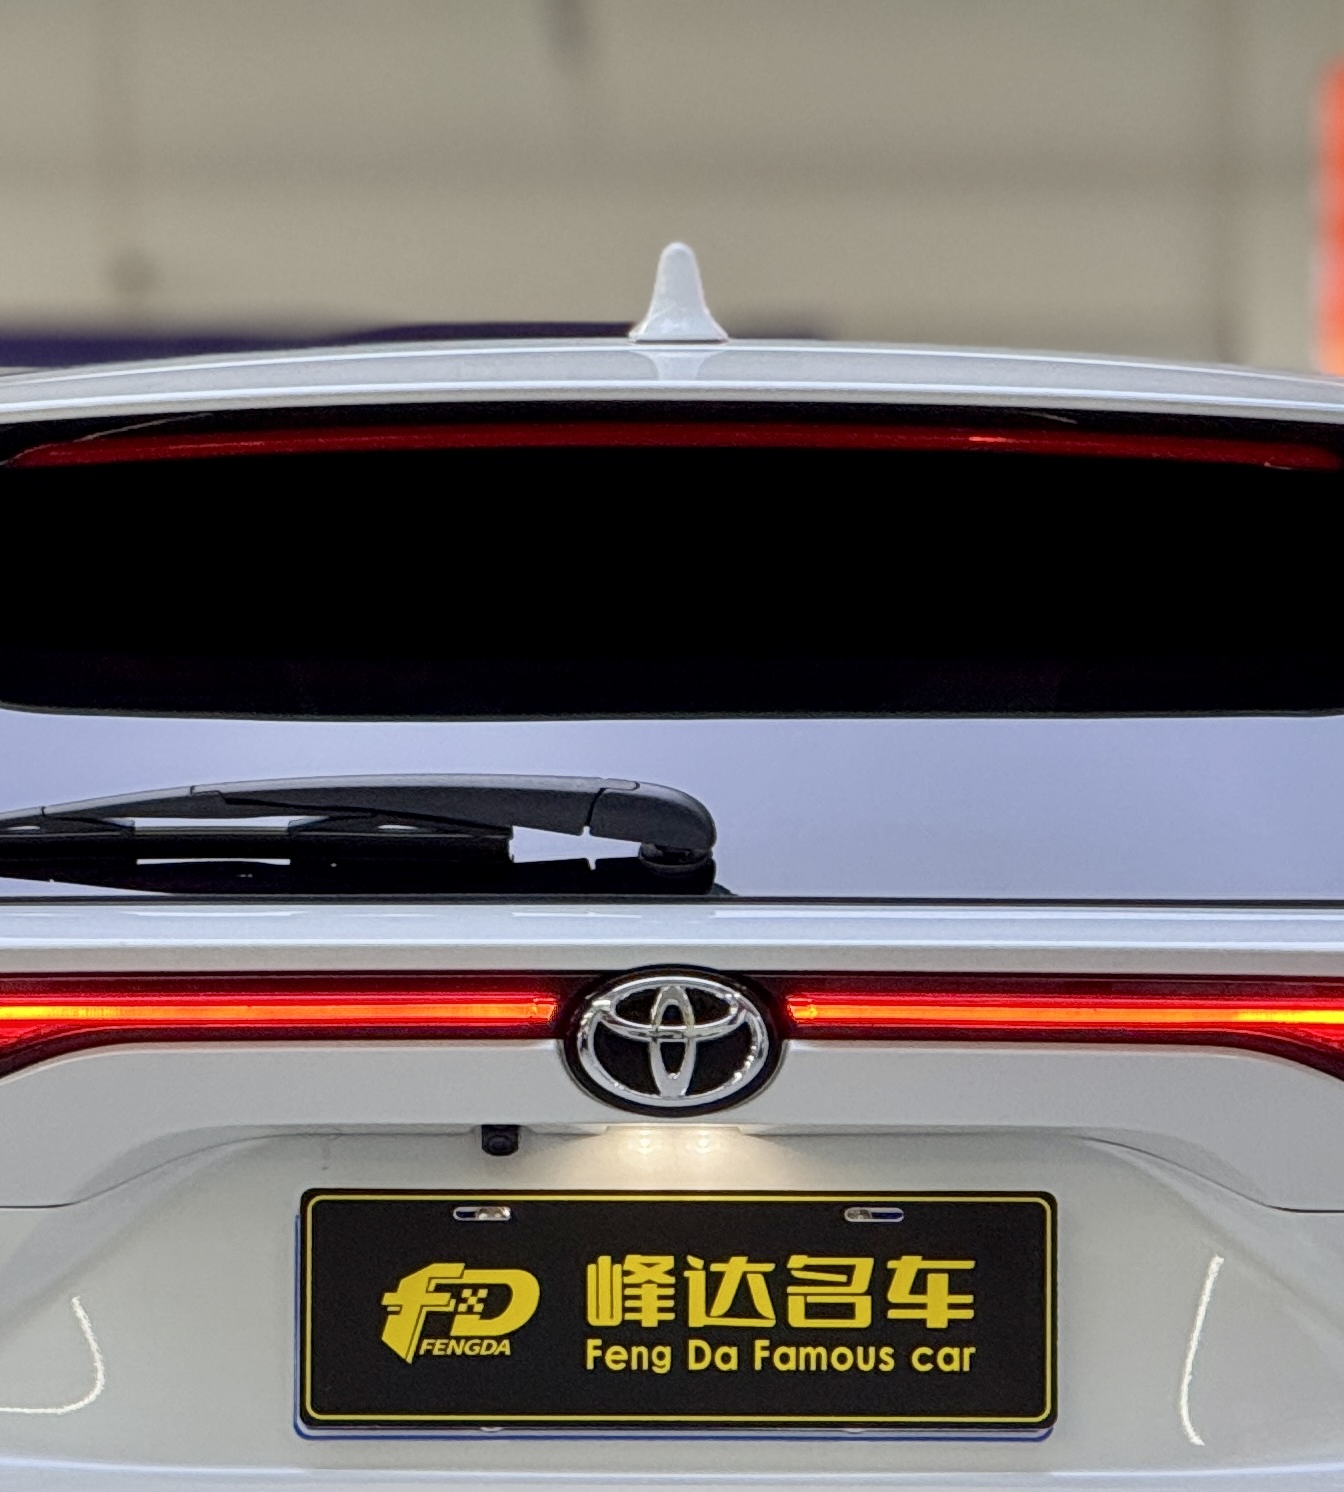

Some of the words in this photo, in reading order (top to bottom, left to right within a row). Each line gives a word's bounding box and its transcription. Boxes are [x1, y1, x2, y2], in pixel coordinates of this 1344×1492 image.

[585, 1254, 976, 1329] 峰达名车
[419, 1338, 512, 1357] FENGDA
[585, 1338, 672, 1374] Feng
[687, 1338, 739, 1371] Da
[753, 1338, 895, 1372] Famous
[910, 1345, 976, 1372] car
